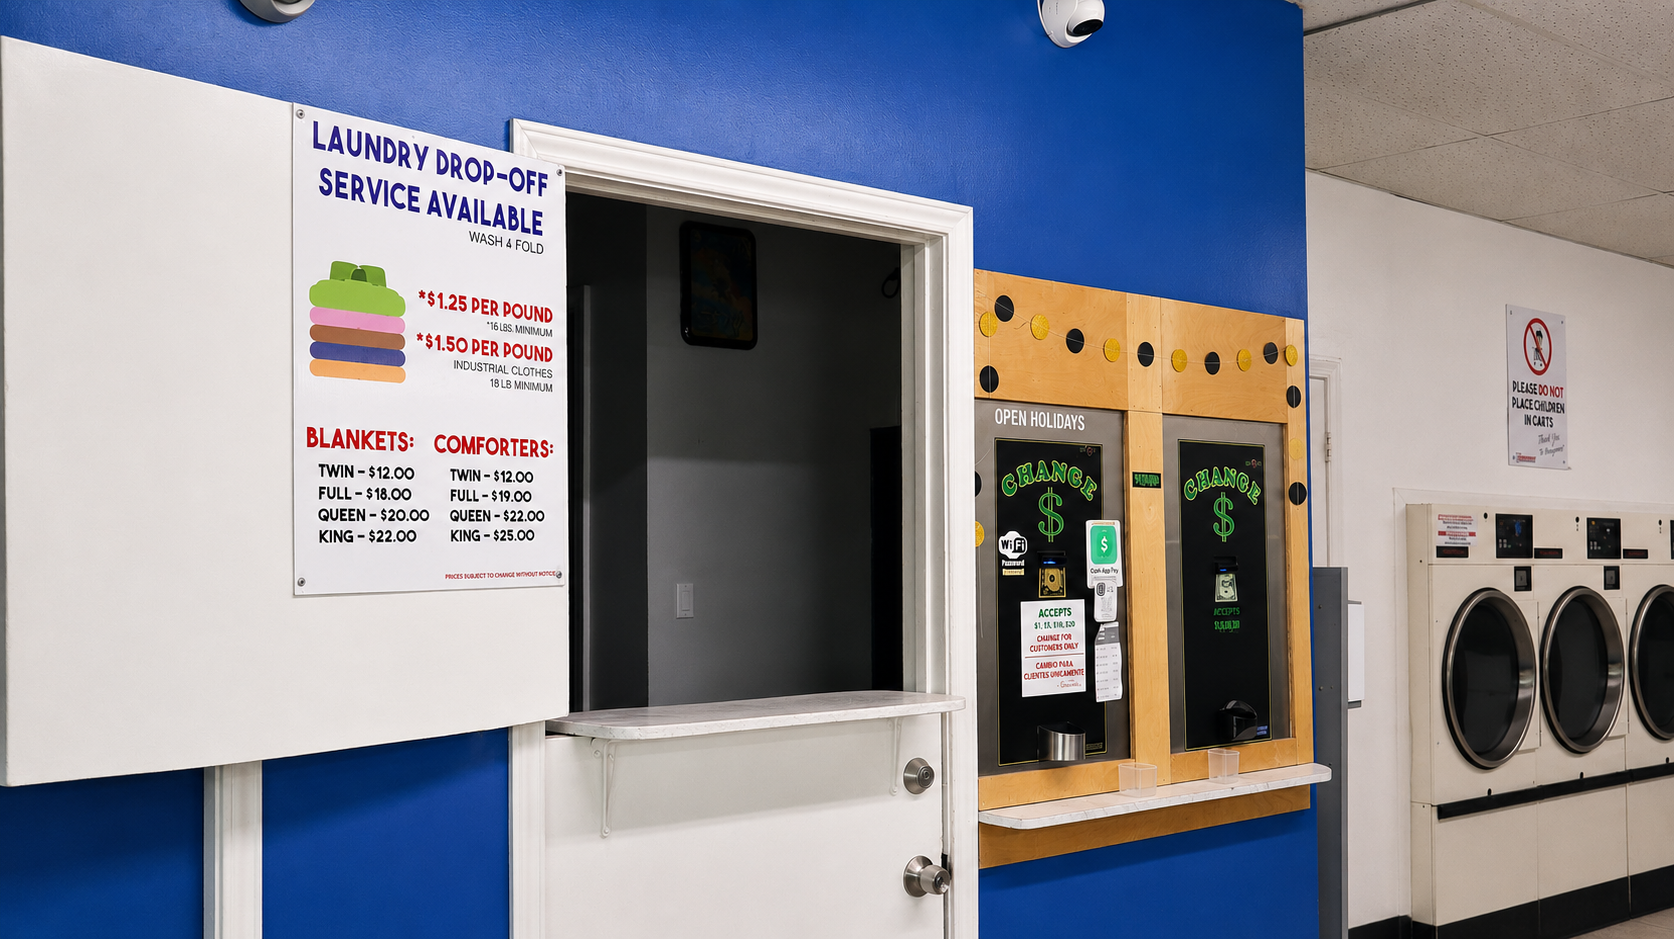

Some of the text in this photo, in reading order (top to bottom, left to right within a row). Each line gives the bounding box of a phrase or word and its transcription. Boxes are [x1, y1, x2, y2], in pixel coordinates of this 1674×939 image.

[312, 120, 549, 197] LAUNDRY DROP-OFF
[318, 167, 543, 236] SERVICE AVAILABLE
[469, 231, 503, 248] WASH
[515, 239, 544, 254] FOLD
[471, 297, 499, 317] PER
[503, 301, 553, 323] POUND
[500, 322, 514, 333] LBS.
[515, 324, 553, 337] MINIMUM
[471, 339, 499, 357] PER
[503, 342, 553, 363] POUND
[453, 360, 553, 379] INDUSTRIAL CLOTHES
[490, 378, 553, 393] 18 LB MINIMUM
[1513, 380, 1564, 398] PLEASE DO NOT
[1512, 396, 1565, 414] PLACE CHILDREN
[994, 408, 1085, 431] OPEN HOLIDAYS
[1524, 414, 1554, 428] IN CARTS
[306, 426, 414, 452] BLANKETS:
[434, 434, 554, 458] COMFORTERS:
[318, 463, 354, 479] TWIN
[369, 466, 415, 480] $12.00
[450, 468, 481, 482] TWIN
[493, 470, 534, 483] $12.00
[1001, 459, 1098, 502] CHANGE
[1183, 466, 1262, 506] CHANGE
[318, 486, 352, 501] FULL
[366, 487, 412, 501] $18.00
[450, 489, 479, 502] FULL
[491, 490, 532, 502] $19.00
[318, 508, 366, 522] QUEEN
[380, 508, 430, 522] $20.00
[449, 509, 491, 522] QUEEN
[503, 510, 545, 522] $22.00
[319, 529, 354, 543] KING
[368, 529, 417, 543] $22.00
[450, 529, 481, 542] KING
[493, 529, 535, 542] $25.00
[1038, 607, 1072, 618] ACCEPTS
[1061, 633, 1072, 641] FOR
[1029, 642, 1079, 653] CUSTOMERS ONLY
